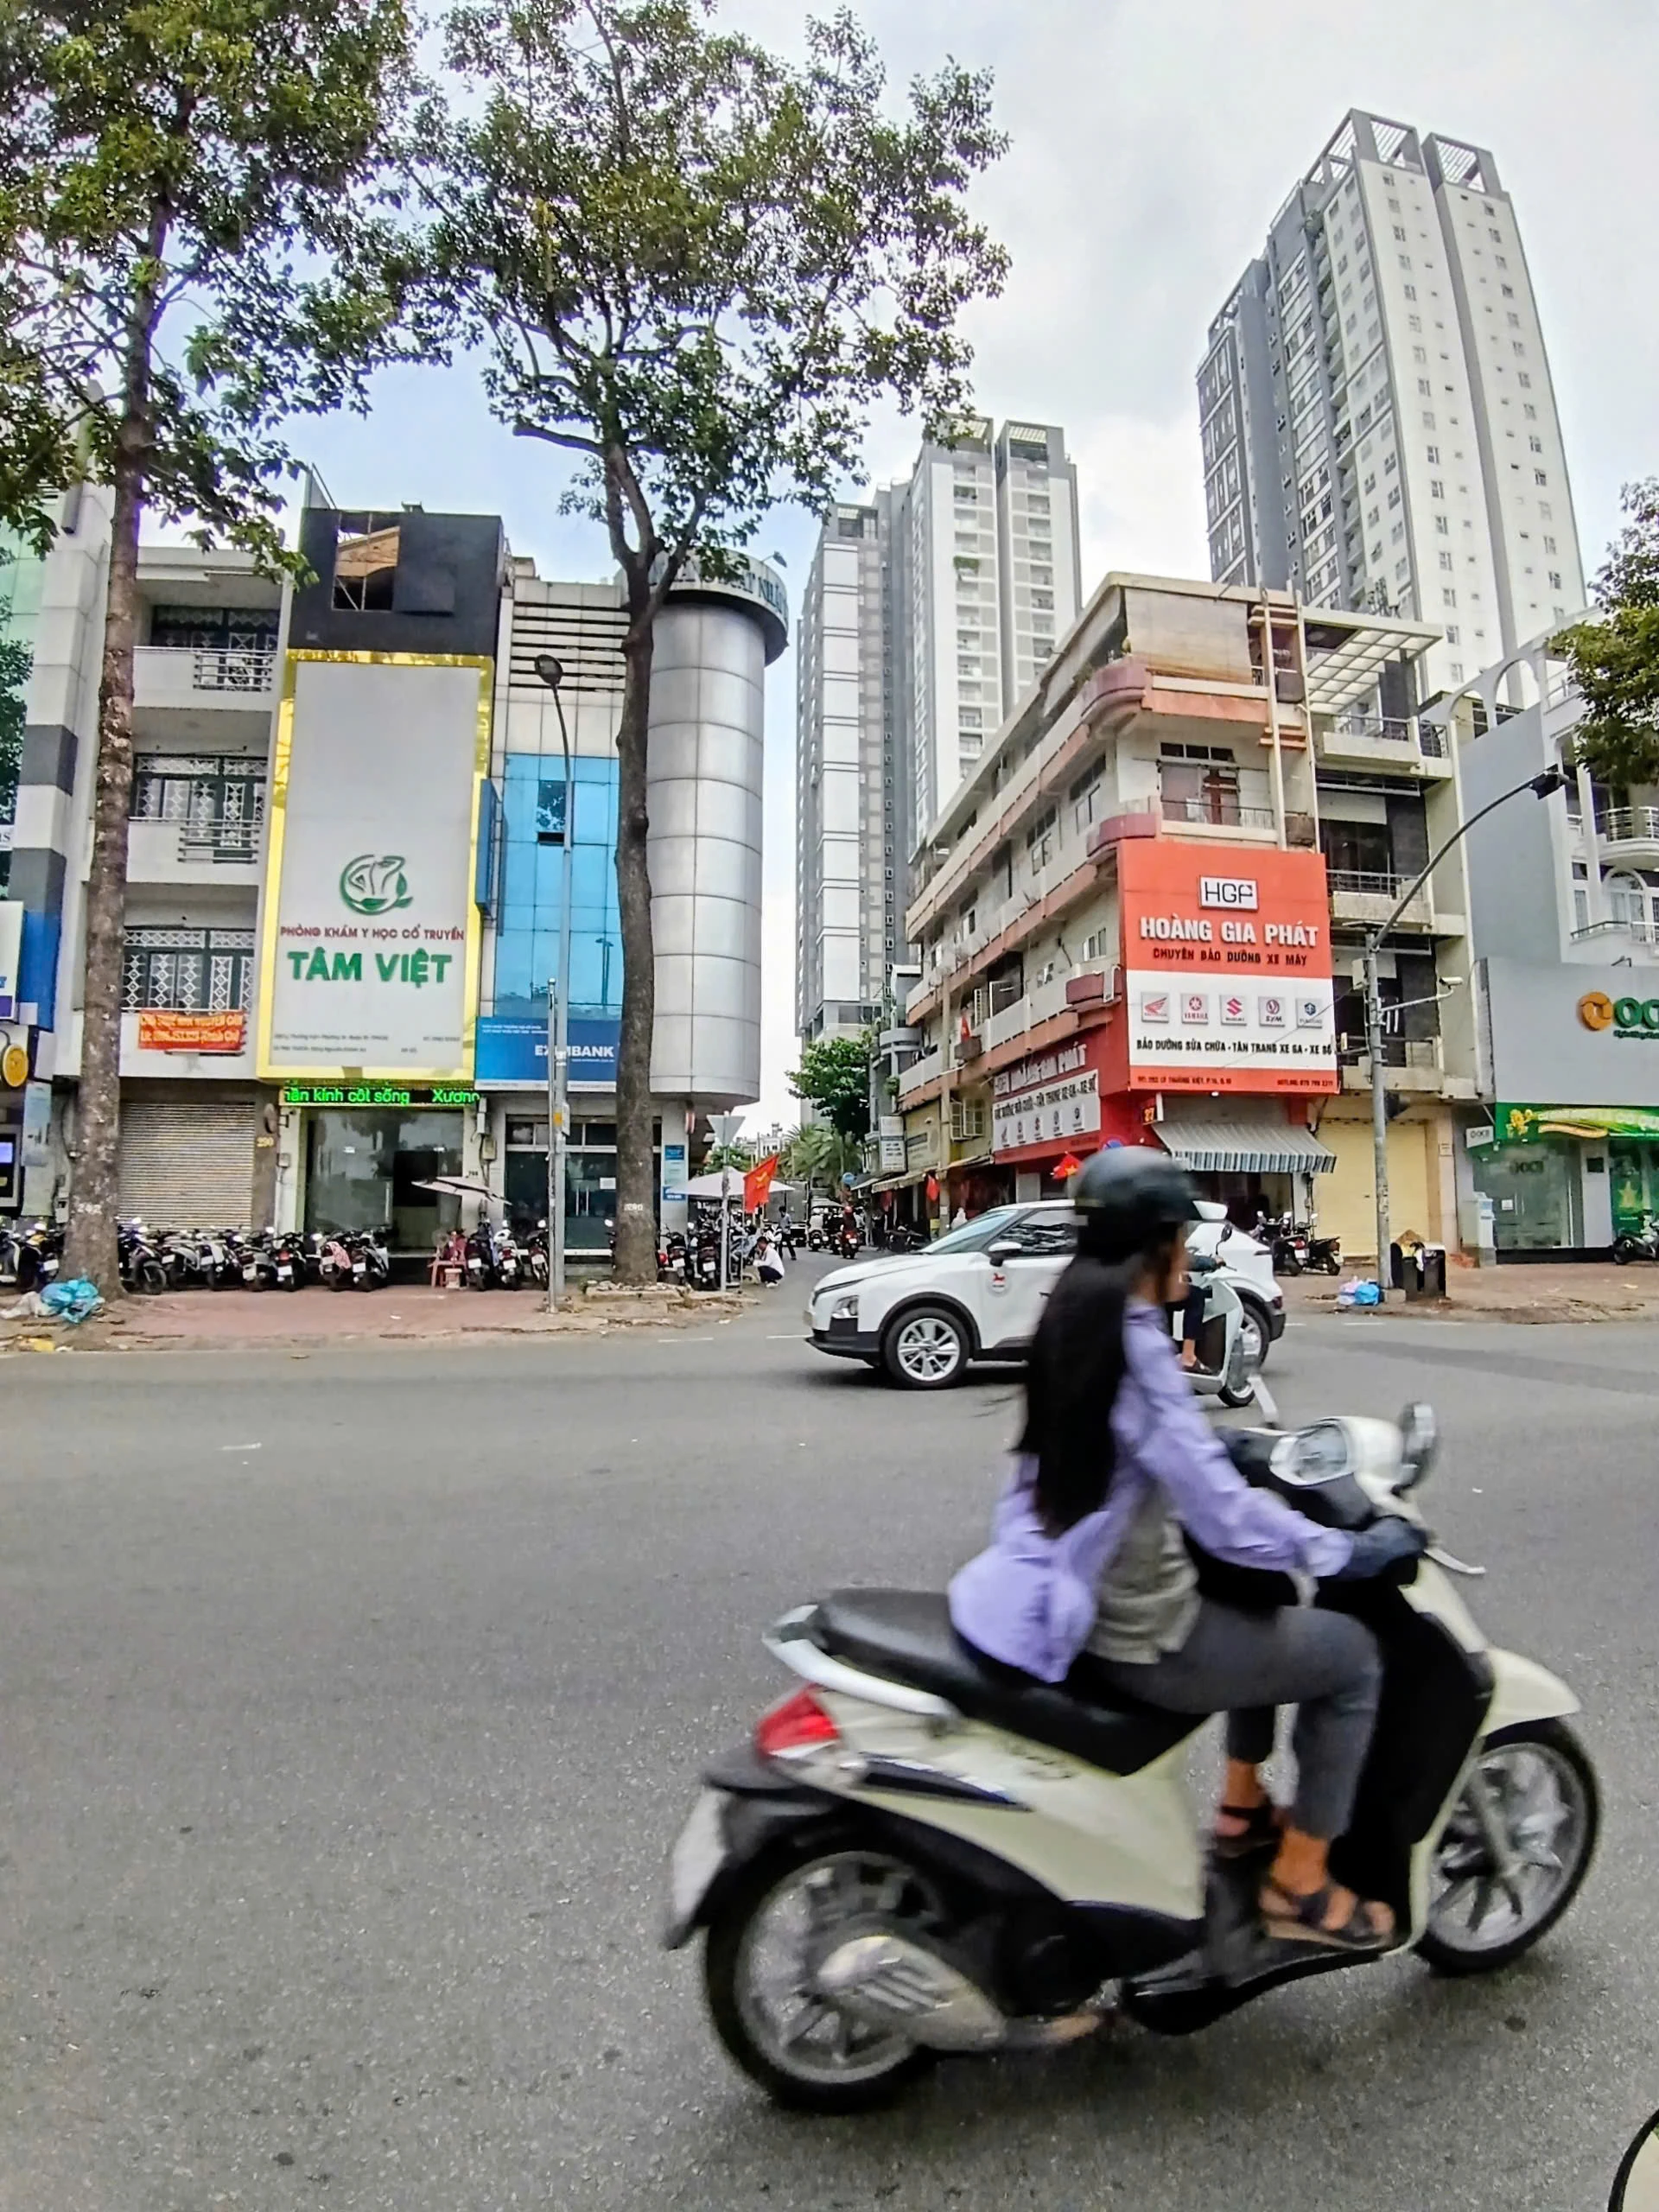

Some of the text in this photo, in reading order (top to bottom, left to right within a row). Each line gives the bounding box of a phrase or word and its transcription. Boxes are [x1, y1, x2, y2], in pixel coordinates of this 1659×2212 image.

[280, 923, 464, 941] PHÒNG KHÁM Y HỌC CỔ TRUYỀN
[1140, 913, 1319, 947] HOÀNG GIA PHÁT
[1153, 947, 1194, 960] CHUYÊN
[1267, 953, 1279, 964] XE
[1285, 953, 1307, 966] MÁY
[287, 946, 453, 988] TÂM VIỆT
[534, 1045, 614, 1058] EXBANK
[1136, 1036, 1153, 1050] BẢO
[1185, 1038, 1201, 1051] SỬA
[1232, 1040, 1249, 1052] TÂN
[1250, 1042, 1277, 1053] TRANG
[1279, 1043, 1290, 1054] XE
[1292, 1044, 1302, 1054] GA
[1310, 1044, 1319, 1054] XE
[314, 1088, 344, 1102] kinh
[374, 1088, 410, 1107] sống
